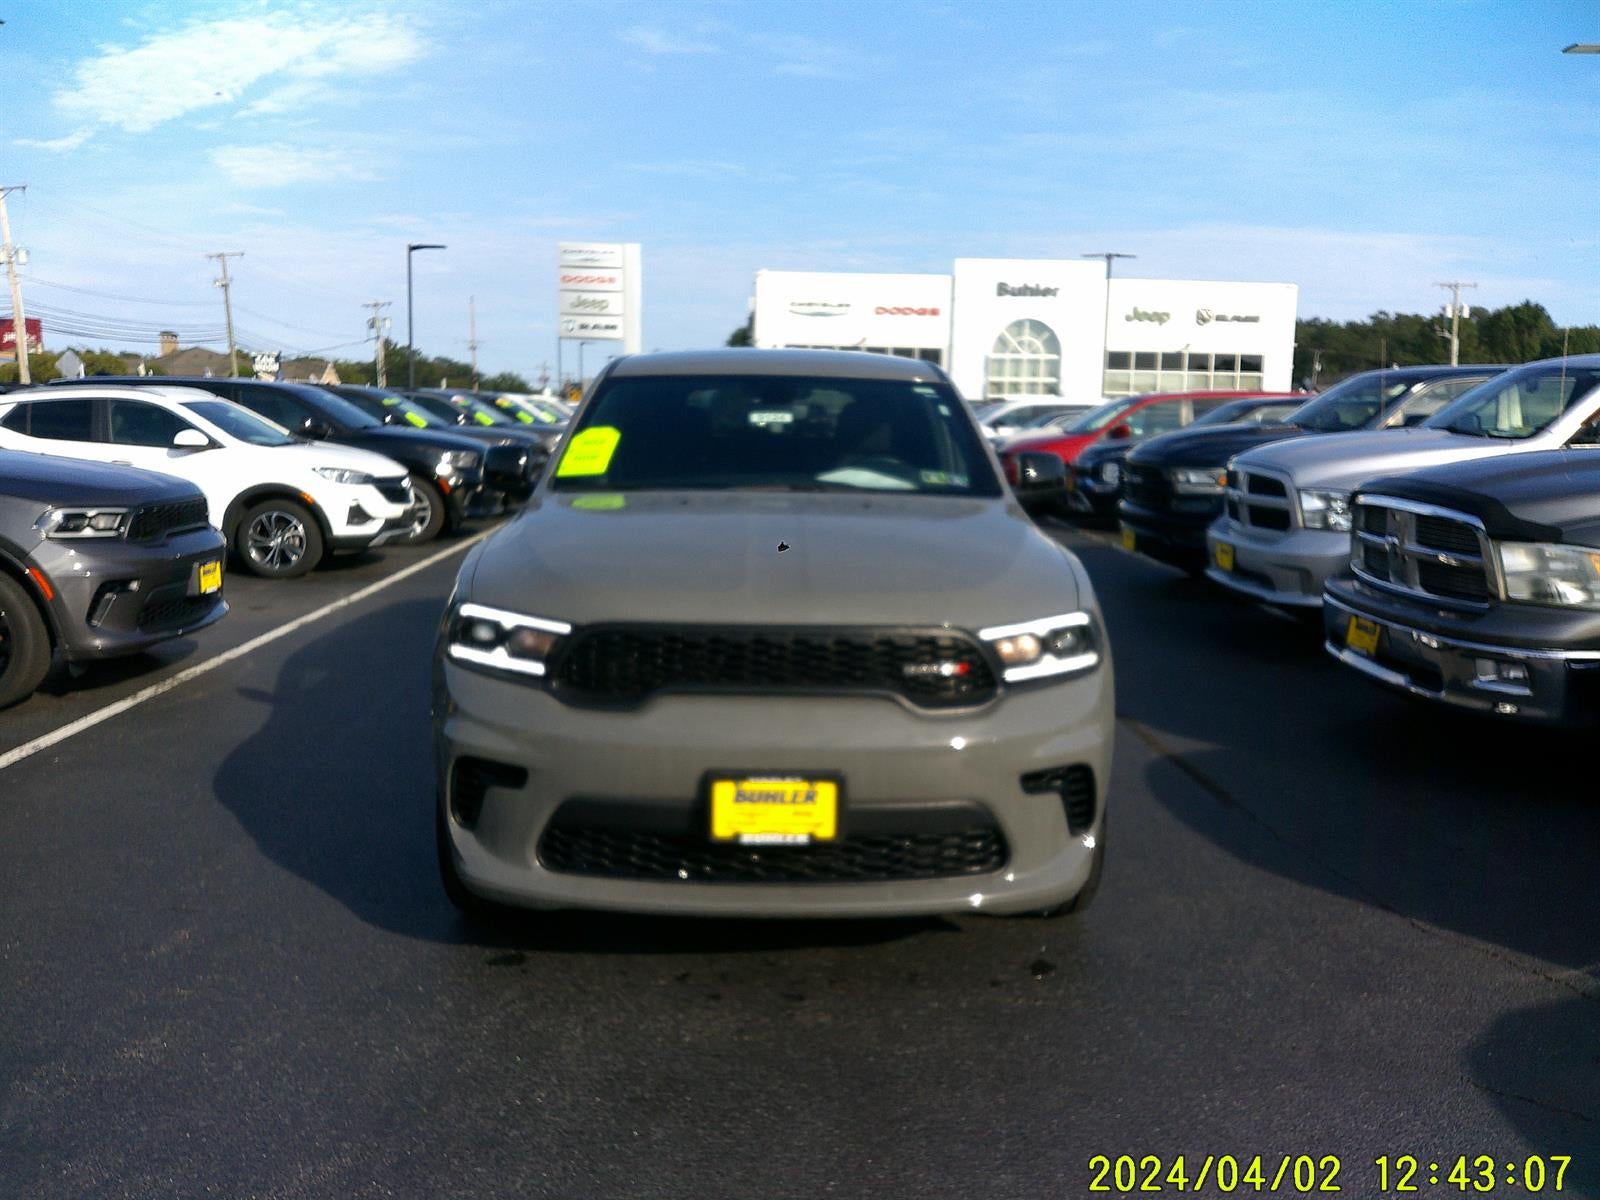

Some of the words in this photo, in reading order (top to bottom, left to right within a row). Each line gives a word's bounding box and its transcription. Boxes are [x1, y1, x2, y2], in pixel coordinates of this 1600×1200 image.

[996, 281, 1060, 298] Buhler
[875, 306, 940, 316] DODGE
[1125, 306, 1170, 326] Jeep
